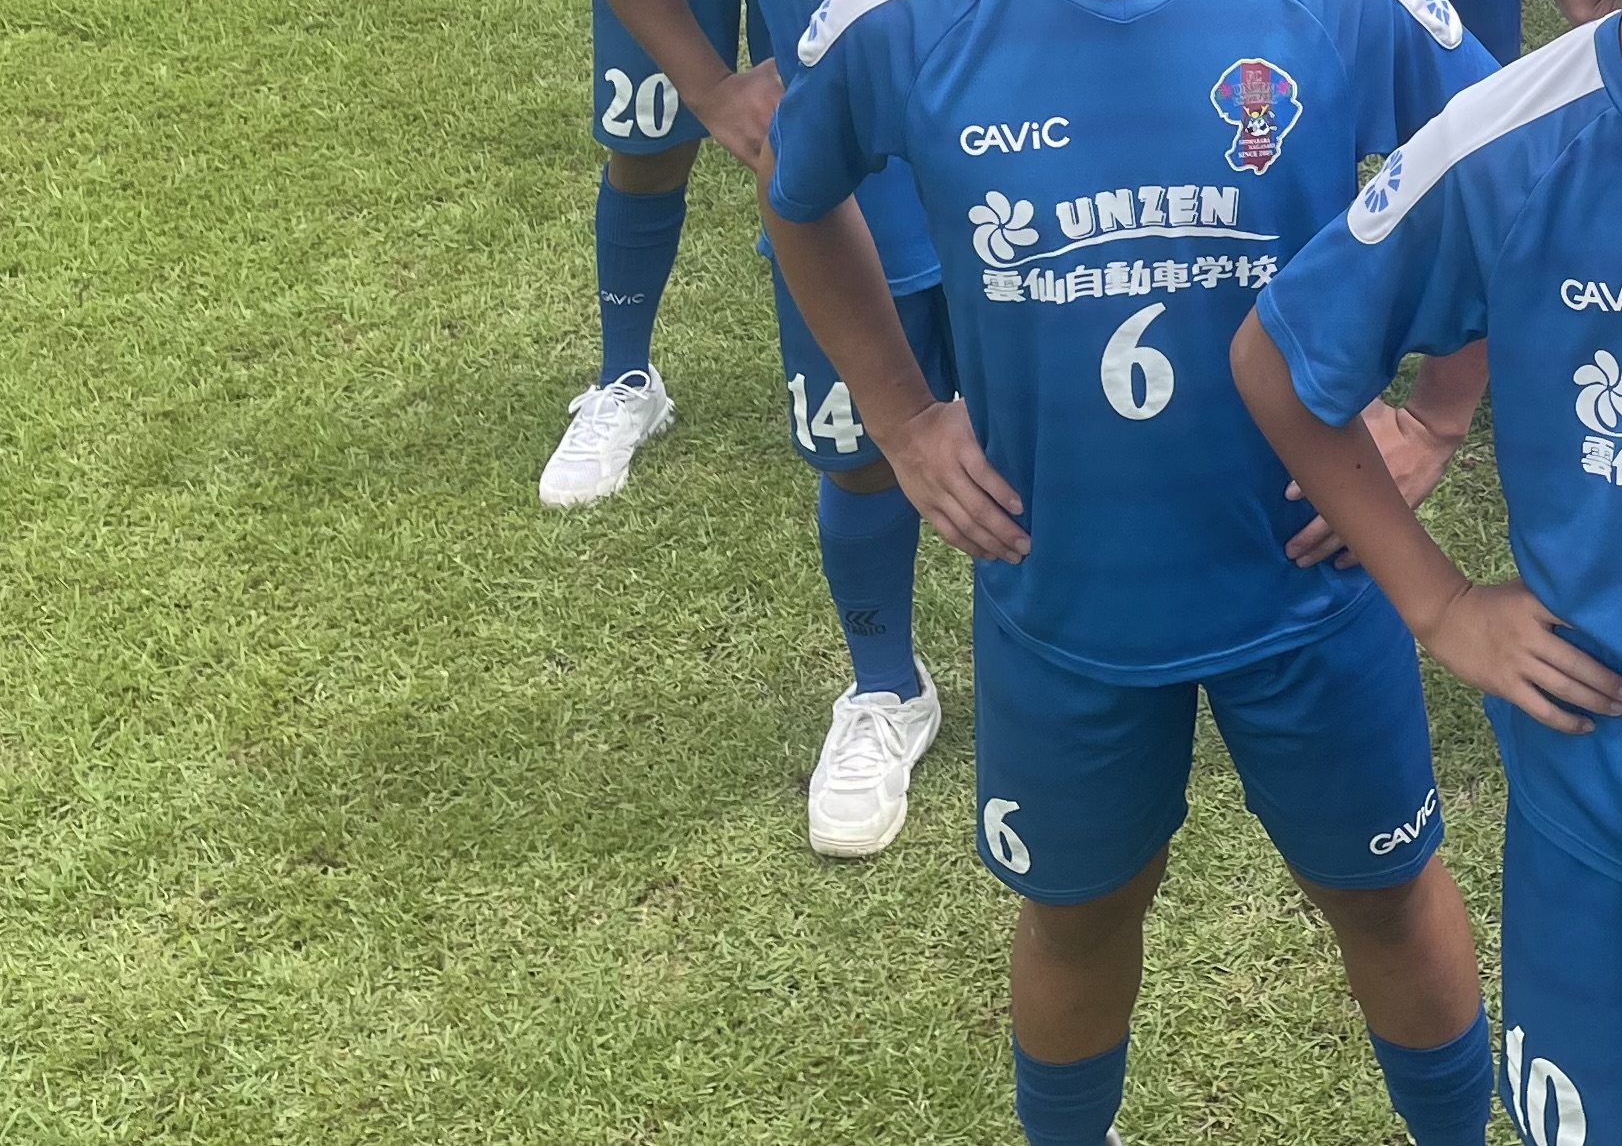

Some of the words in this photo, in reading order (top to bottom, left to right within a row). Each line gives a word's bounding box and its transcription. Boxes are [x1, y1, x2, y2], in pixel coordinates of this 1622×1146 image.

[602, 68, 679, 138] 20
[960, 117, 1071, 156] GAViC
[1056, 185, 1240, 240] UNZEN
[982, 255, 1278, 304] 雲仙自動車学校
[1100, 302, 1175, 420] 6
[788, 373, 864, 453] 14
[983, 797, 1031, 874] 6
[1505, 1025, 1587, 1146] 10
